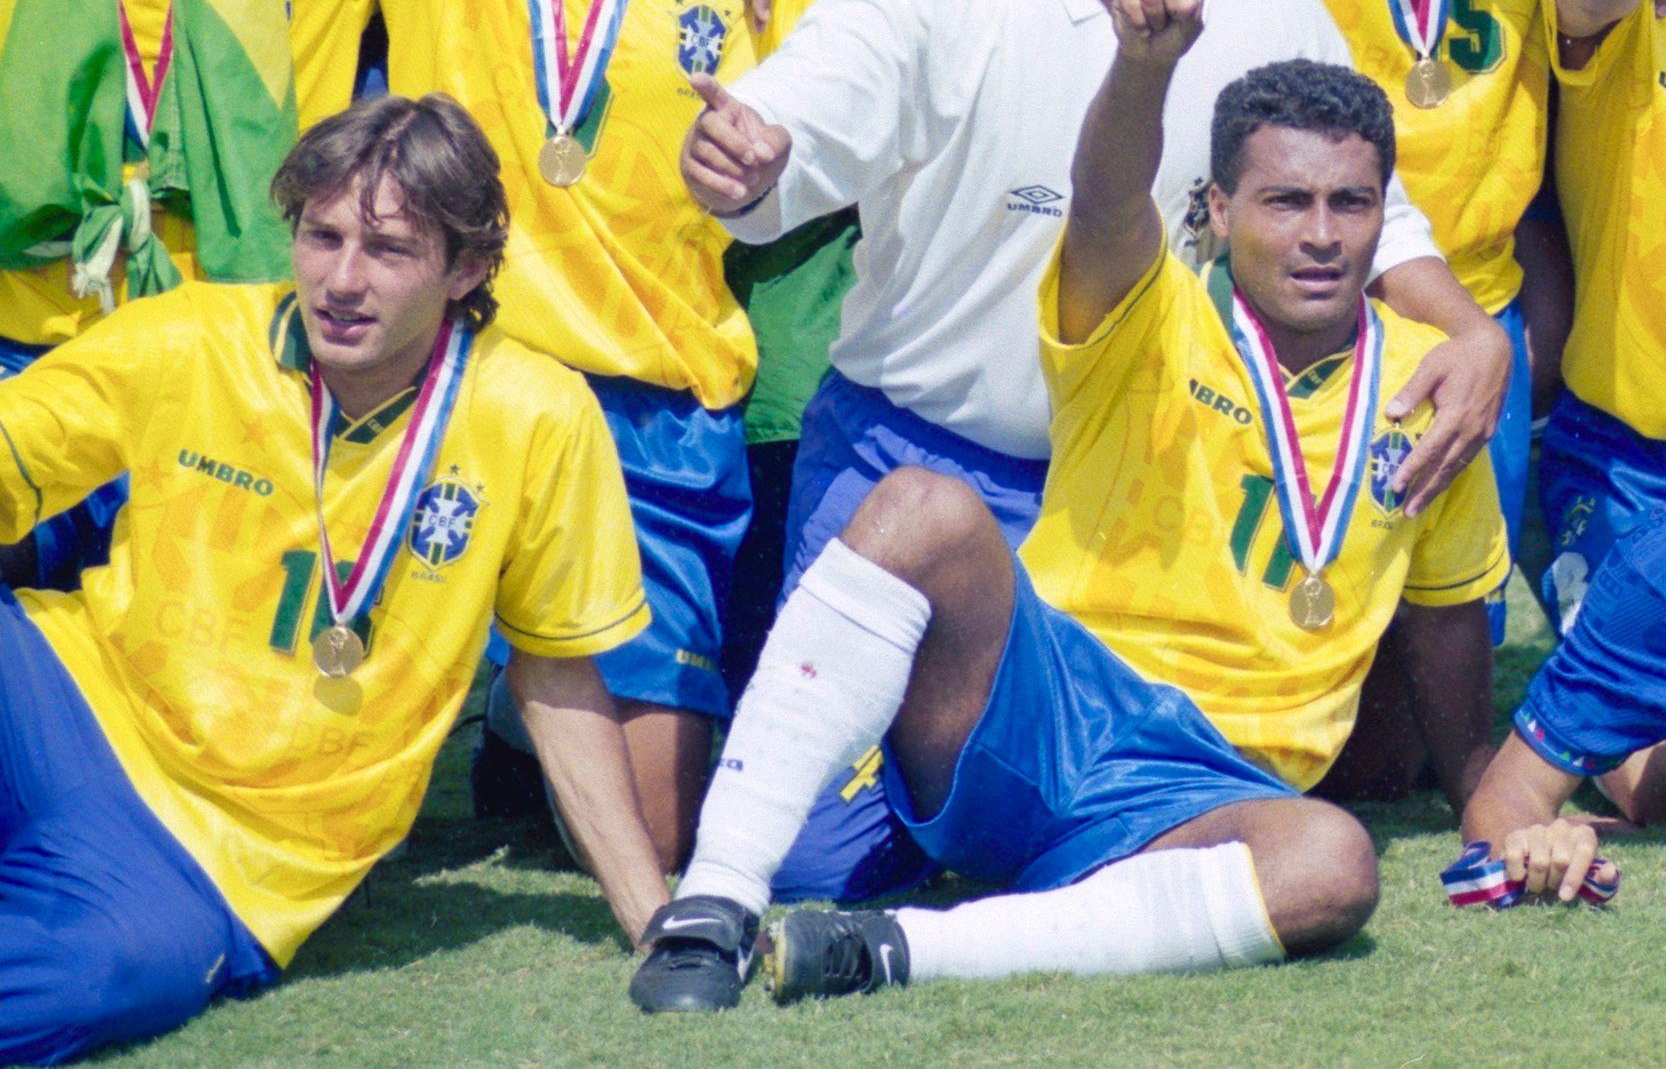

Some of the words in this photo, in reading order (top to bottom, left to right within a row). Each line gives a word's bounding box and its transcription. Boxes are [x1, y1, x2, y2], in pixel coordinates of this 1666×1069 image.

[1007, 203, 1063, 218] UMBRO
[178, 448, 274, 497] UMBRO
[428, 513, 457, 529] CBF
